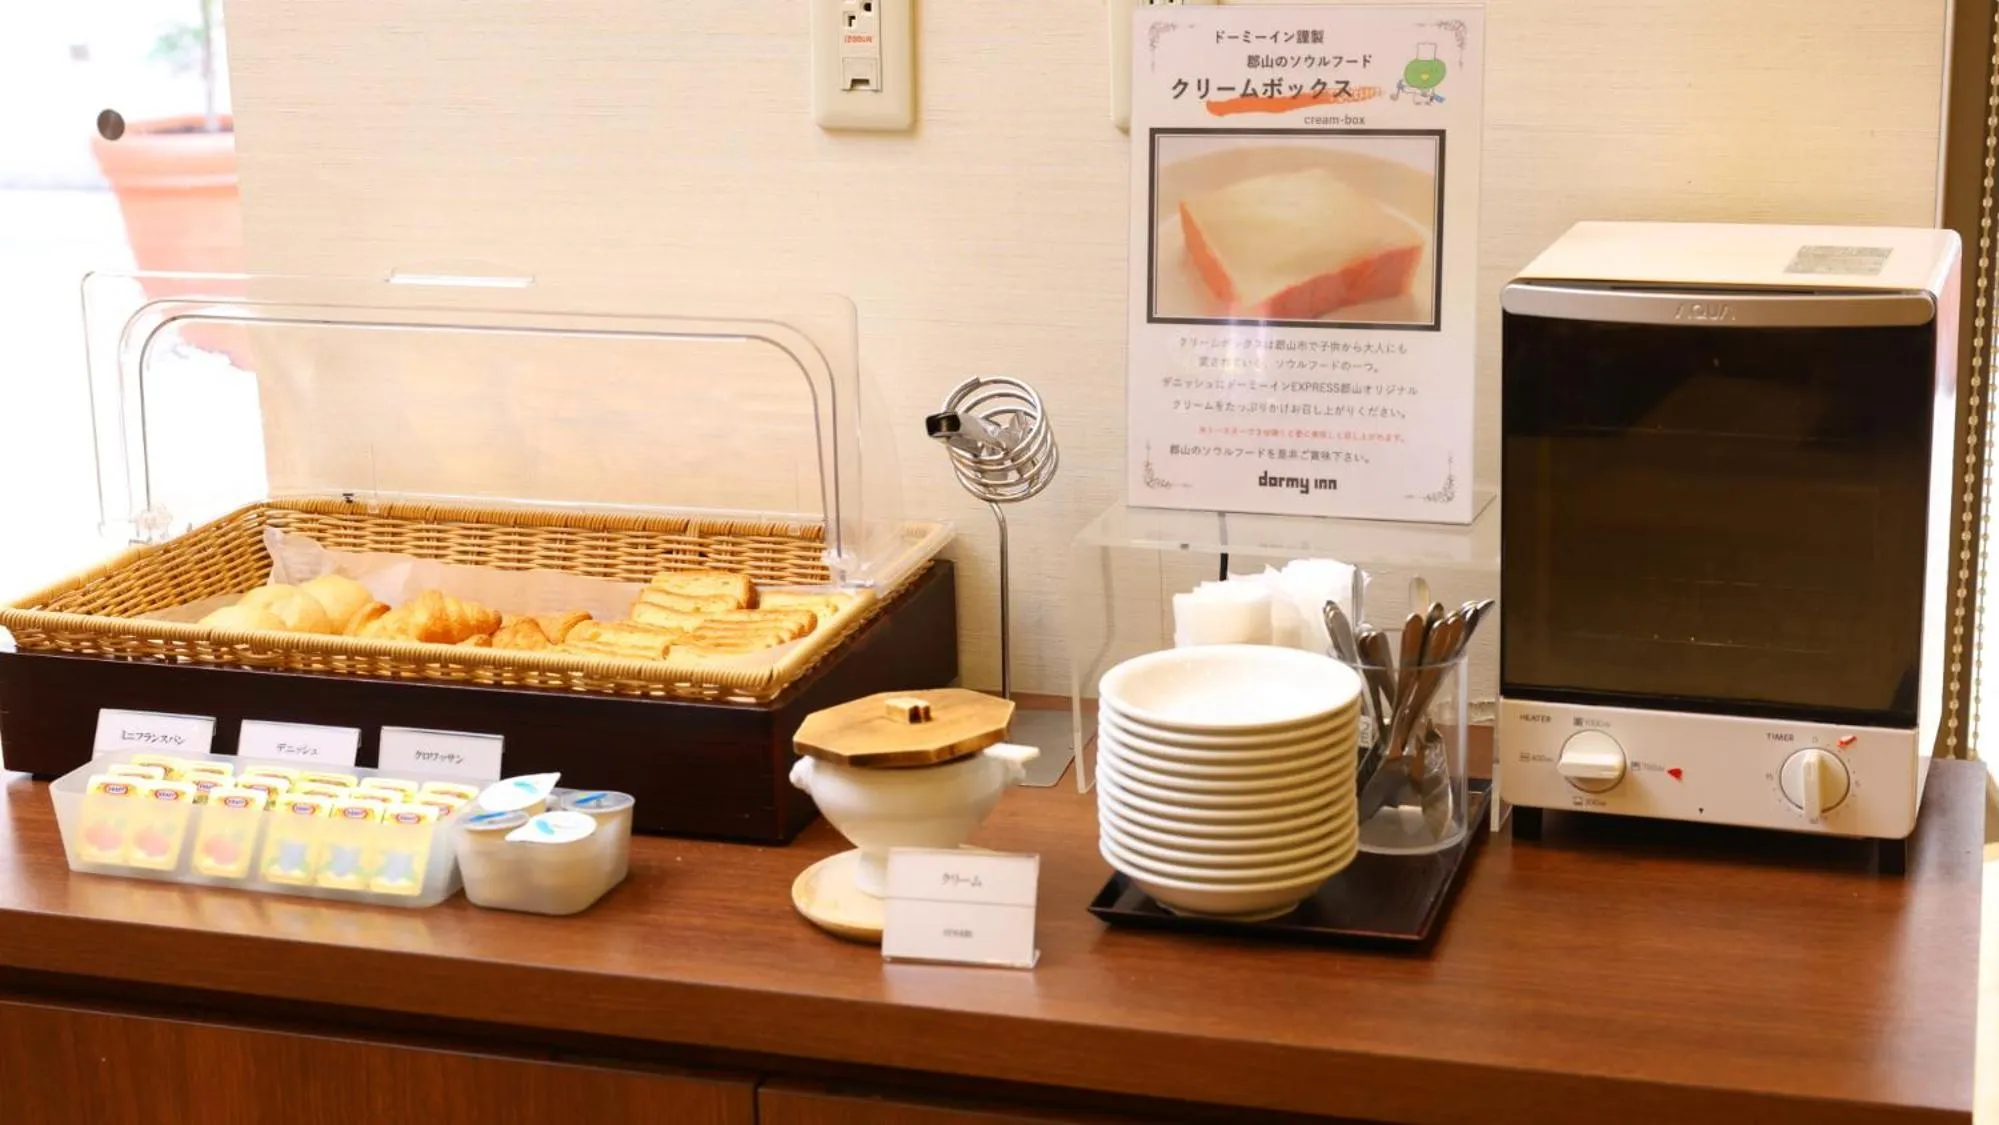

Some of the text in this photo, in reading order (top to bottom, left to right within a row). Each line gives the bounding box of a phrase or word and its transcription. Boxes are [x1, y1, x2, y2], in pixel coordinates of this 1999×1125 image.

[1215, 30, 1325, 44] ドーミーイン謹製
[1247, 54, 1373, 69] 郡山のソウルフード
[1171, 77, 1352, 100] クリームボックス
[1304, 114, 1366, 126] cream-box
[1258, 470, 1338, 494] dormy inn
[1518, 713, 1552, 724] HEATER
[120, 729, 186, 746] ミニフランスパン
[1765, 731, 1795, 743] TIMER
